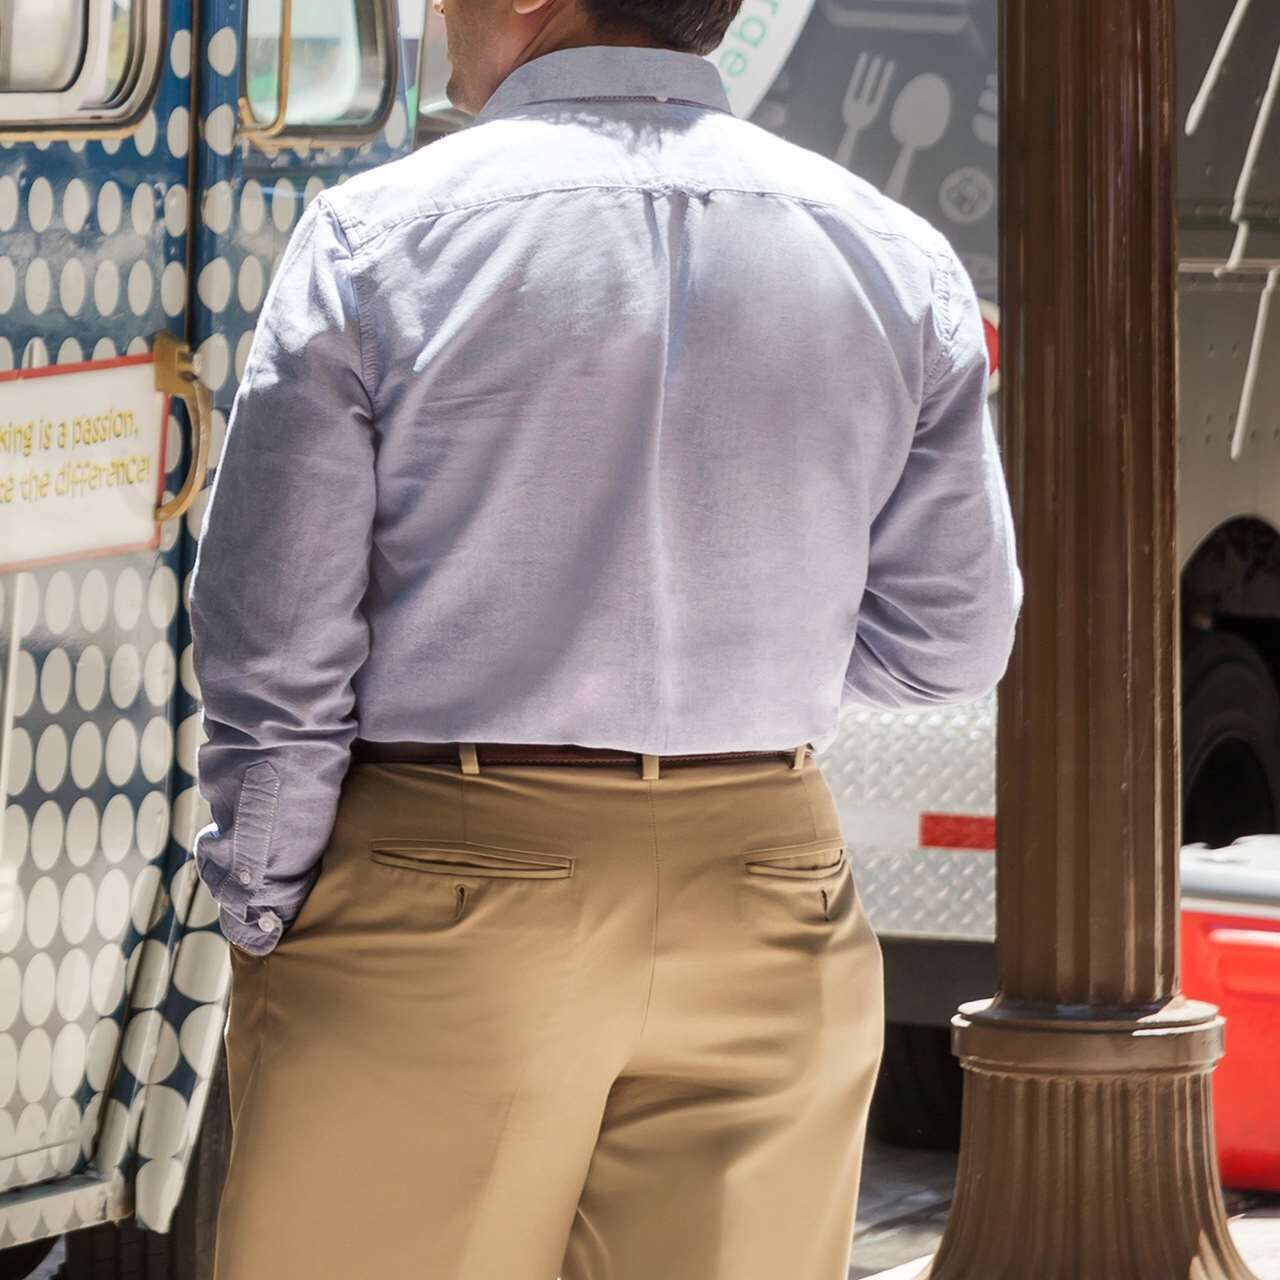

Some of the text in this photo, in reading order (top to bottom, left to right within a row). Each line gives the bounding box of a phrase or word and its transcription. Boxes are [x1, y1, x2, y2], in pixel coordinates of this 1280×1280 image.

[39, 419, 53, 450] is
[57, 418, 68, 449] a
[20, 468, 50, 503] the
